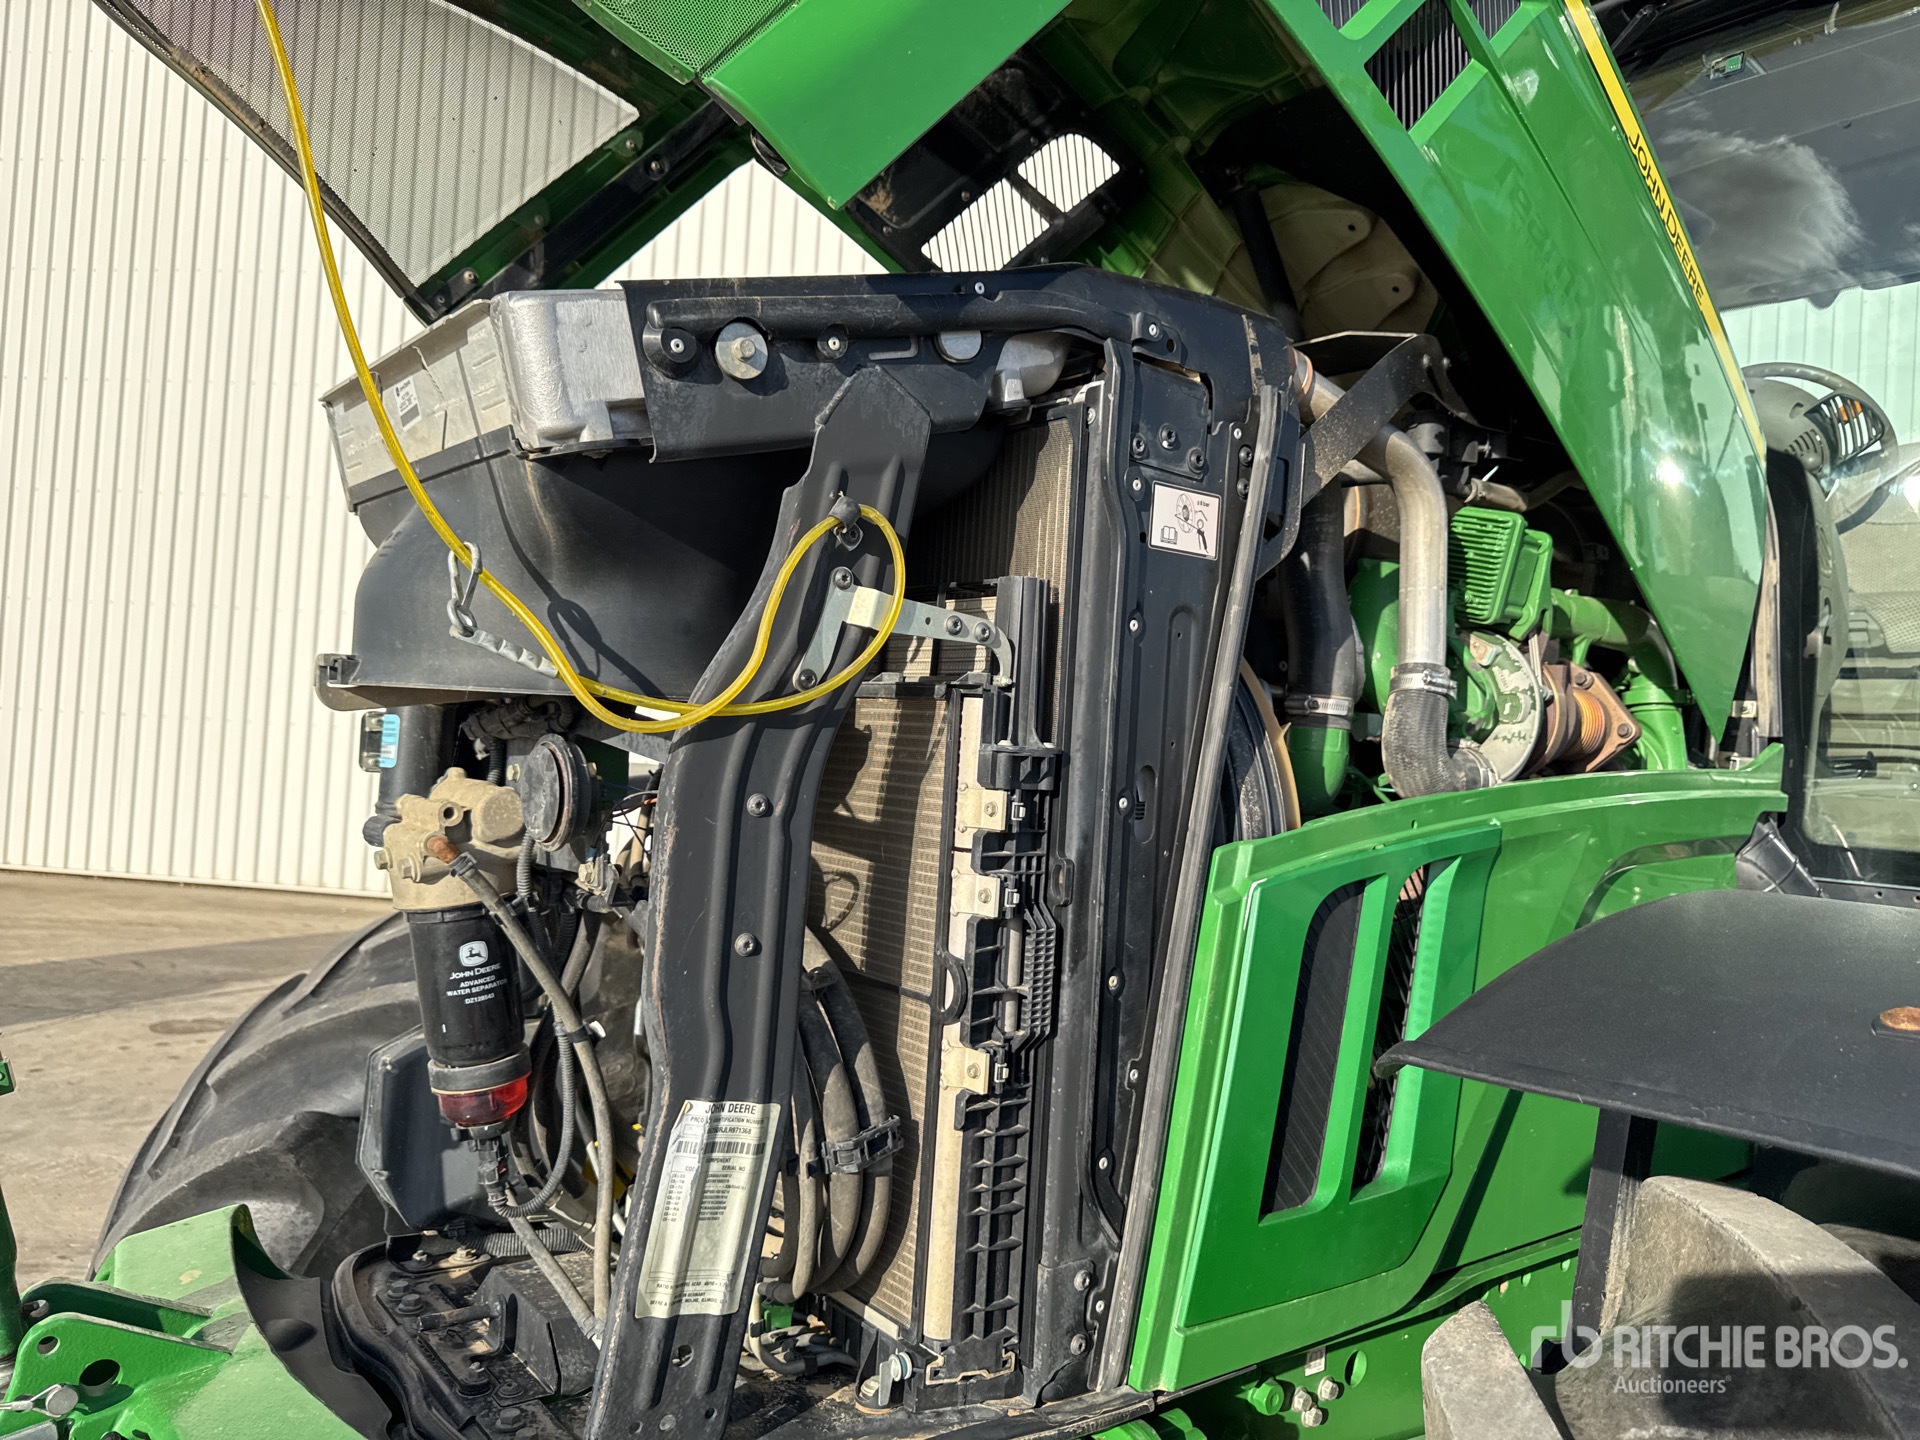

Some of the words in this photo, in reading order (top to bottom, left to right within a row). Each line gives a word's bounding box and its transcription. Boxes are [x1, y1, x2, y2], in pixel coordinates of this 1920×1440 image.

[1629, 133, 1665, 214] JOHN
[1665, 208, 1704, 305] DEERE
[449, 970, 474, 980] JOHN
[474, 963, 501, 975] DEERE
[446, 988, 470, 996] WATER
[471, 978, 507, 993] SEPARATOR
[460, 975, 495, 988] ADVANCED
[705, 1103, 725, 1114] JOHN
[728, 1103, 757, 1115] DEERE
